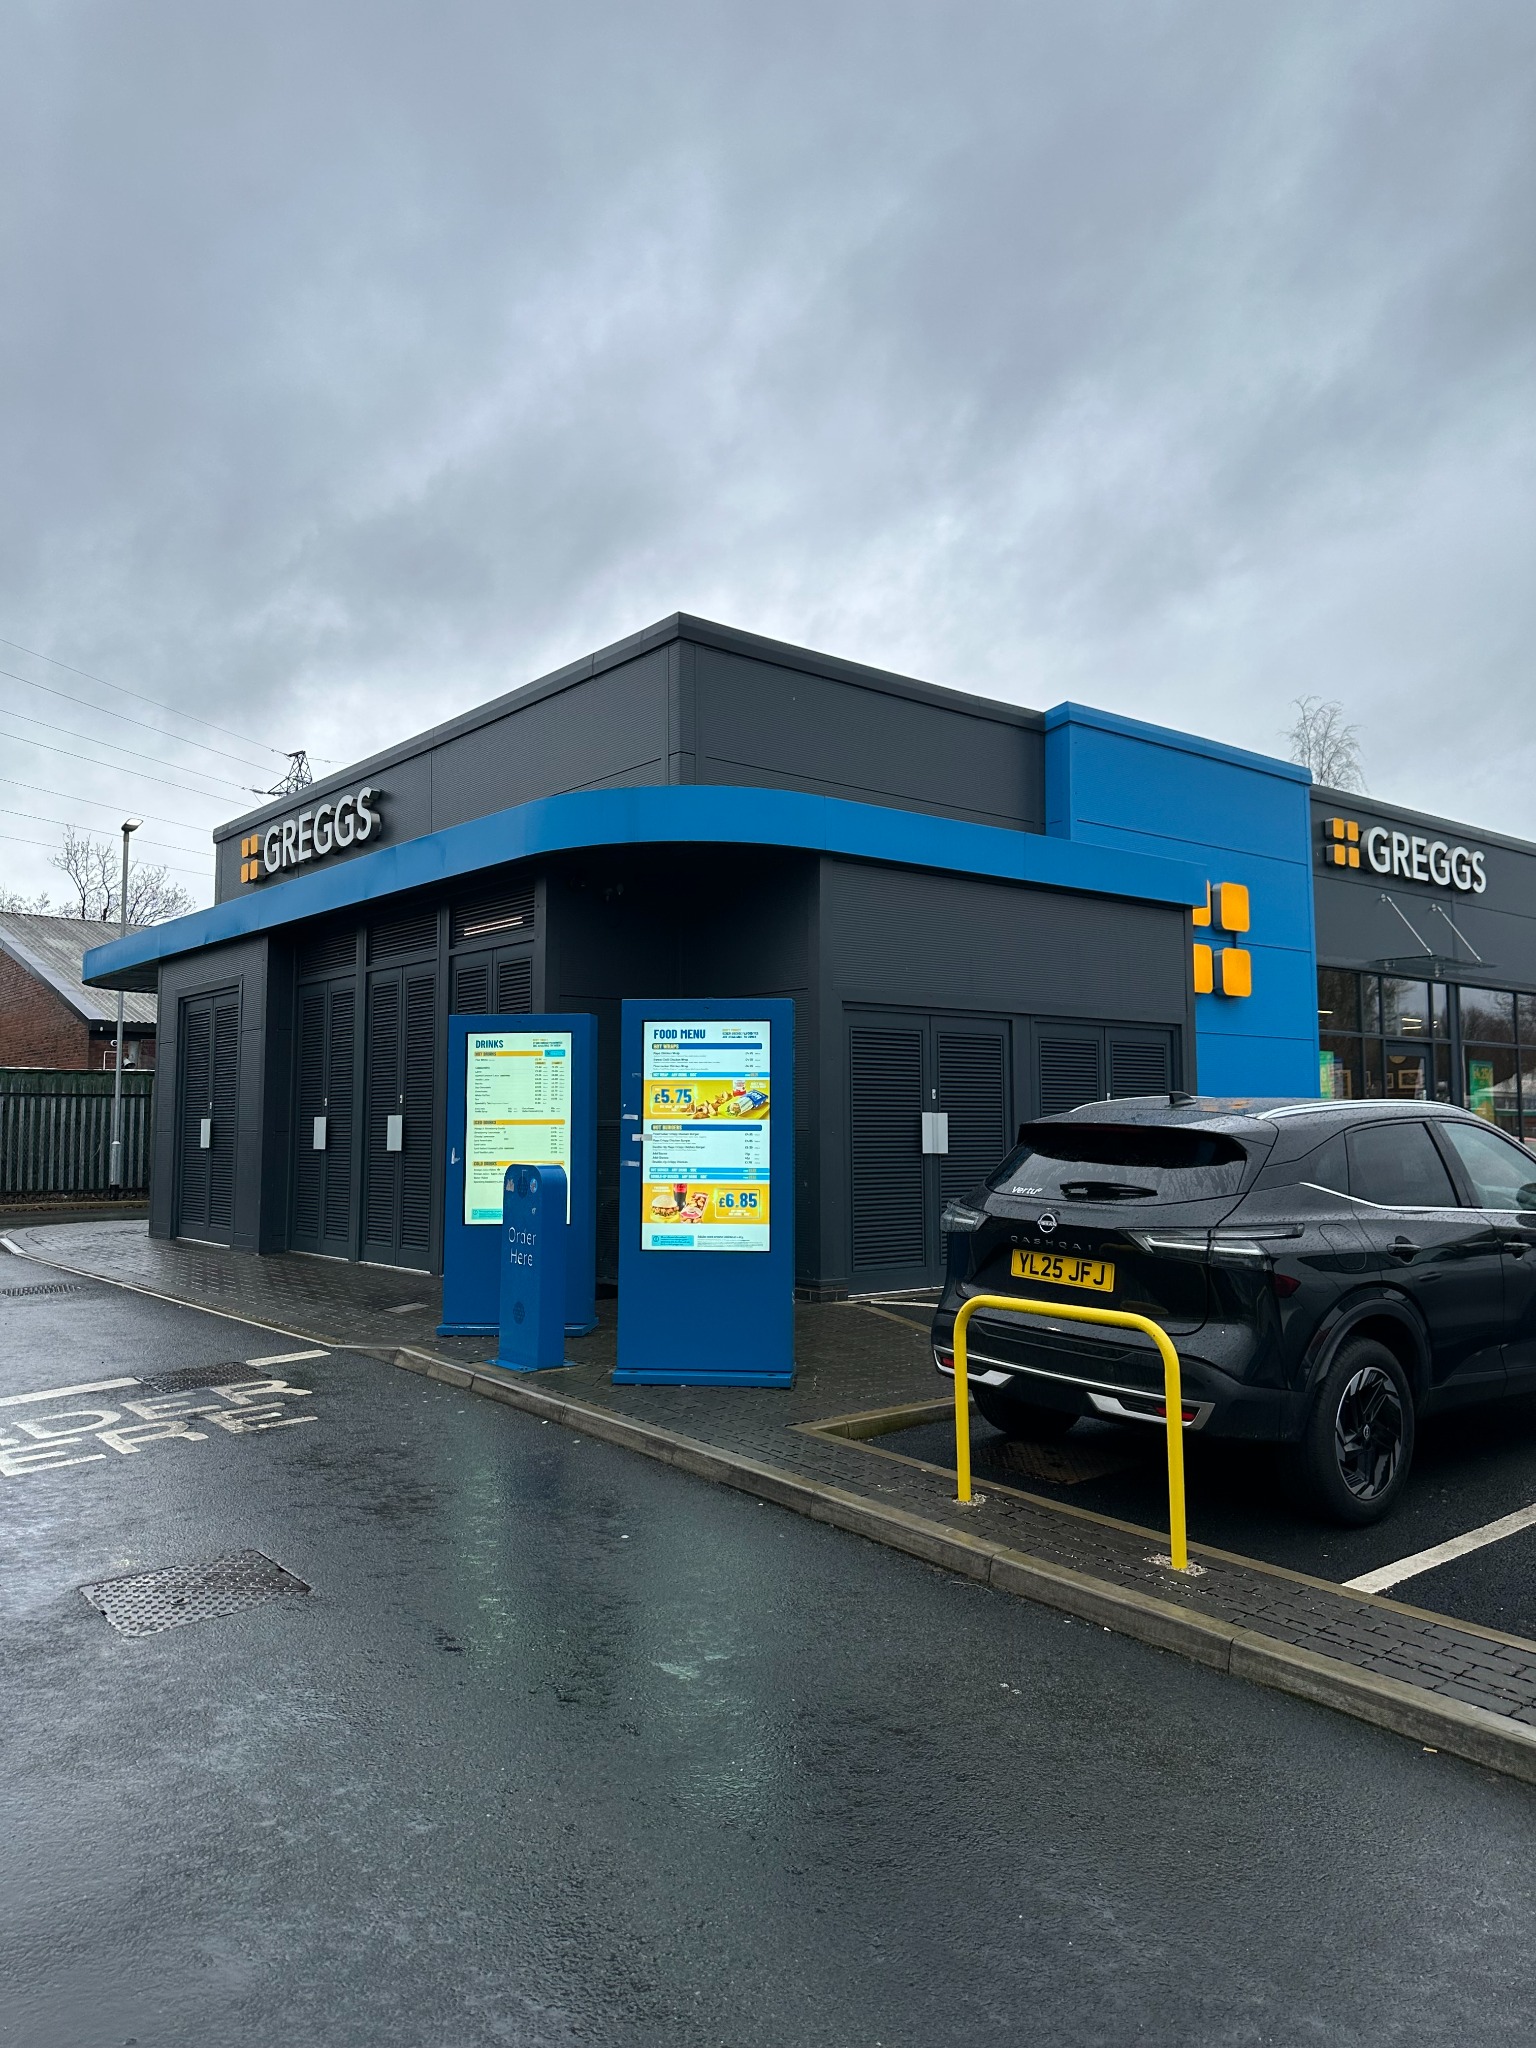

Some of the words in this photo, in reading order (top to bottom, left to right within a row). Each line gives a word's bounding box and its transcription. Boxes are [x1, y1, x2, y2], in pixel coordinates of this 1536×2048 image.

[263, 787, 377, 873] GREGGS
[1367, 826, 1487, 893] GREGGS
[653, 1029, 678, 1040] FOOD
[680, 1029, 706, 1040] MENU
[475, 1039, 504, 1049] DRINKS
[654, 1088, 692, 1104] £5.75
[718, 1192, 758, 1209] £6.85
[508, 1226, 537, 1246] Order
[1010, 1235, 1093, 1251] QASHQAI
[509, 1248, 533, 1267] Here
[1019, 1252, 1064, 1279] YL25
[1068, 1260, 1106, 1286] JFJ
